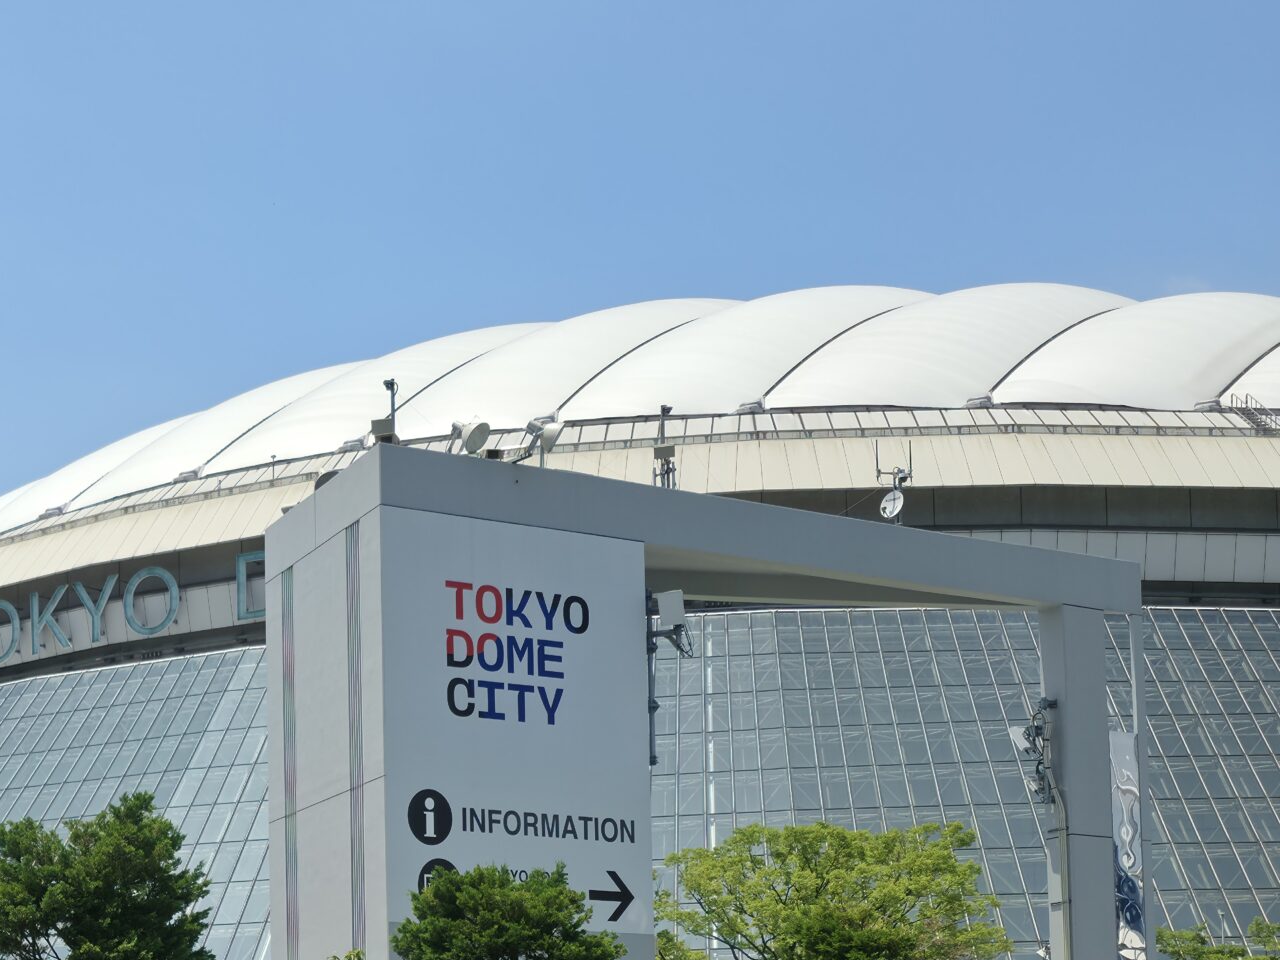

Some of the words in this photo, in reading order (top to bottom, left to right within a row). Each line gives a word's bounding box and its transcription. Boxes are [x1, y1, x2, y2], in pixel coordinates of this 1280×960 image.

[445, 579, 590, 634] TOKYO
[446, 628, 565, 679] DOME
[447, 677, 564, 725] CITY
[461, 807, 636, 844] INFORMATION
